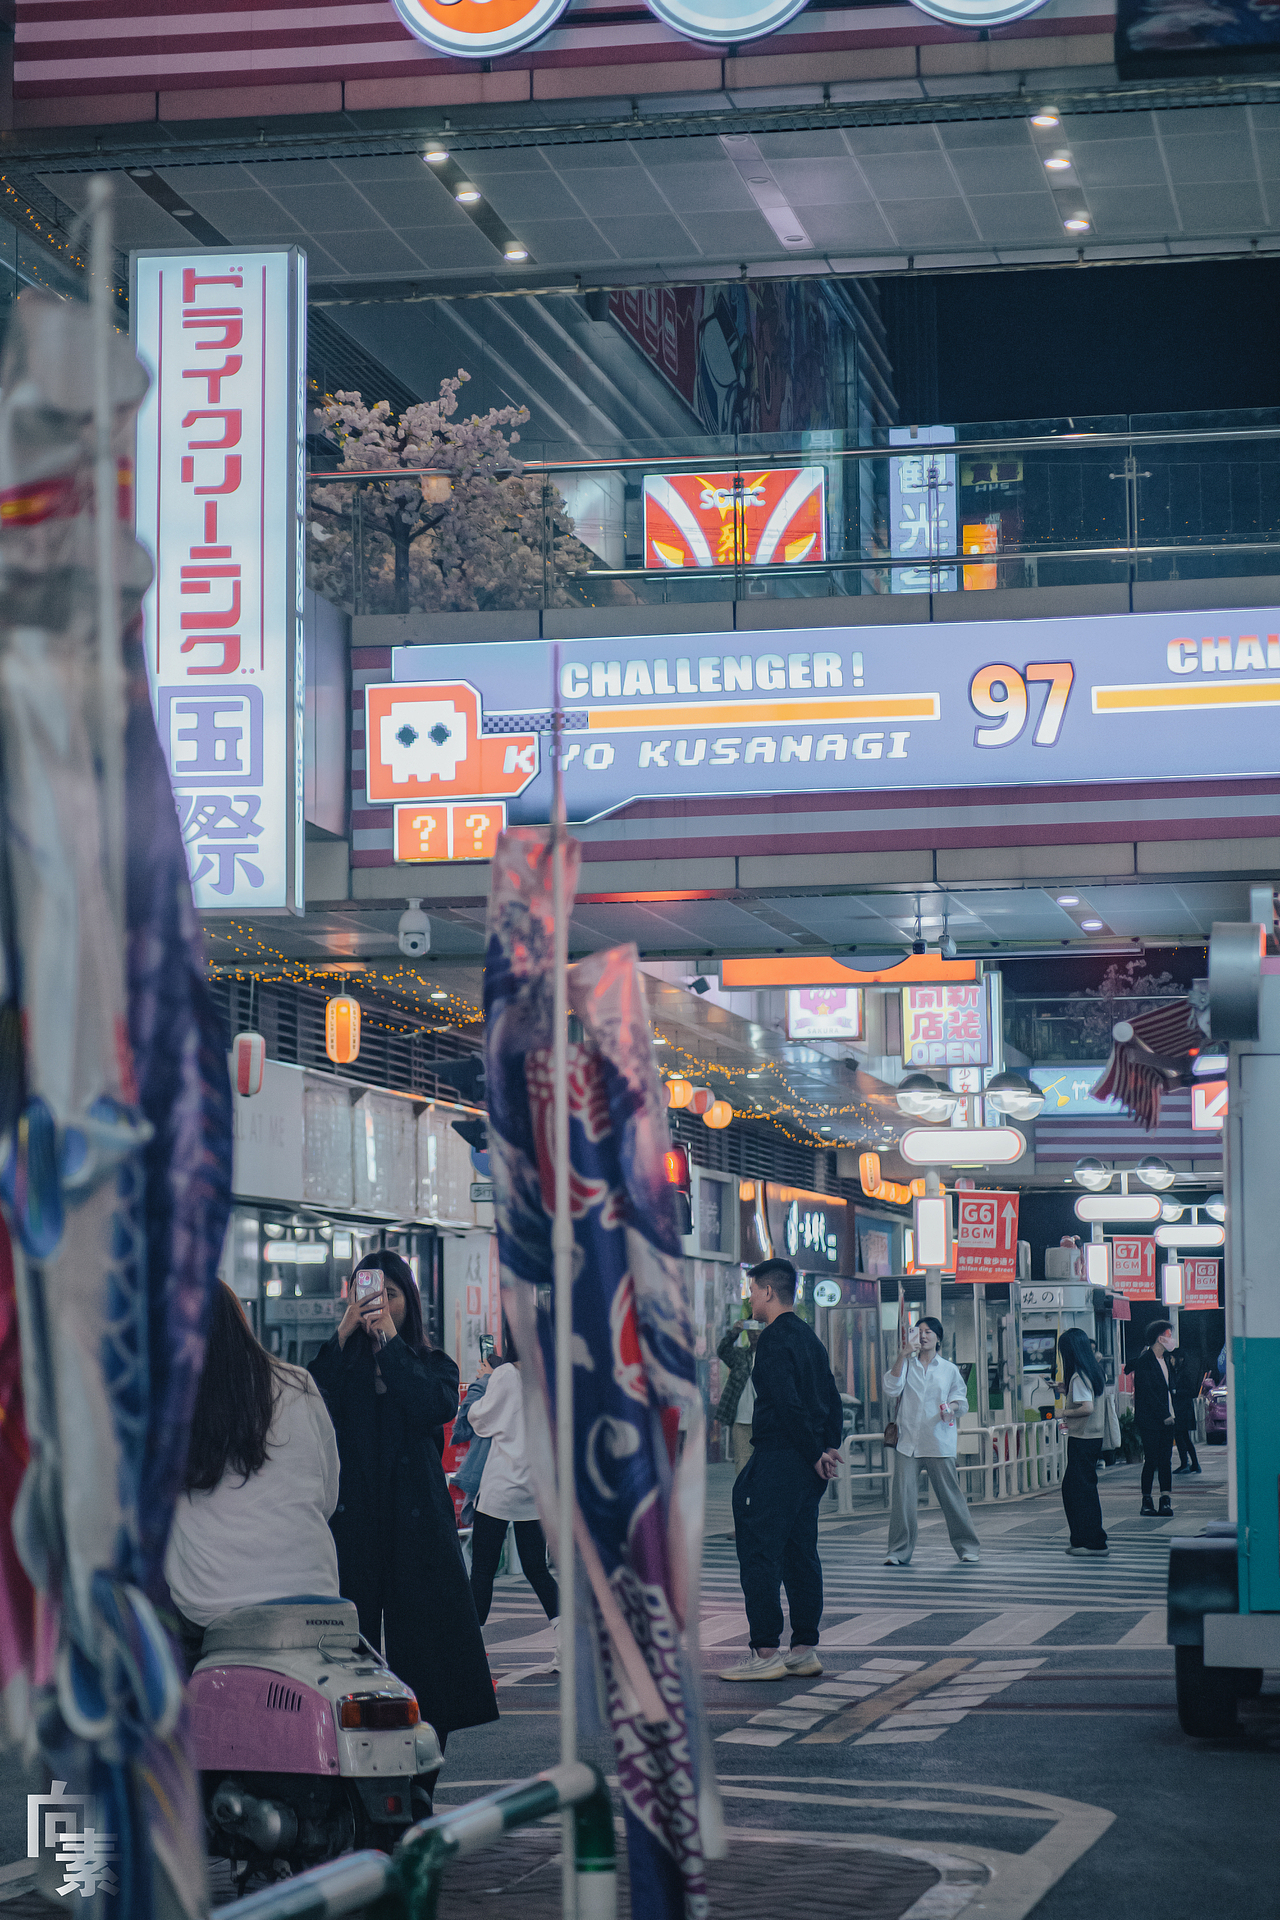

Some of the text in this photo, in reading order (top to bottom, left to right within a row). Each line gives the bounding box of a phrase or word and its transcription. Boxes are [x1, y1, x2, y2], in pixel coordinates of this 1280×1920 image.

[699, 486, 766, 510] SONIC
[560, 652, 864, 698] CHALLENGER!
[968, 659, 1075, 749] 97
[638, 731, 910, 768] KUSANAGI
[911, 1041, 981, 1065] OPEN
[963, 1204, 992, 1223] G6
[961, 1227, 994, 1239] BGM
[1116, 1244, 1138, 1258] G7
[1115, 1261, 1140, 1269] BGM
[1198, 1265, 1215, 1276] G8
[1196, 1277, 1216, 1285] BGM
